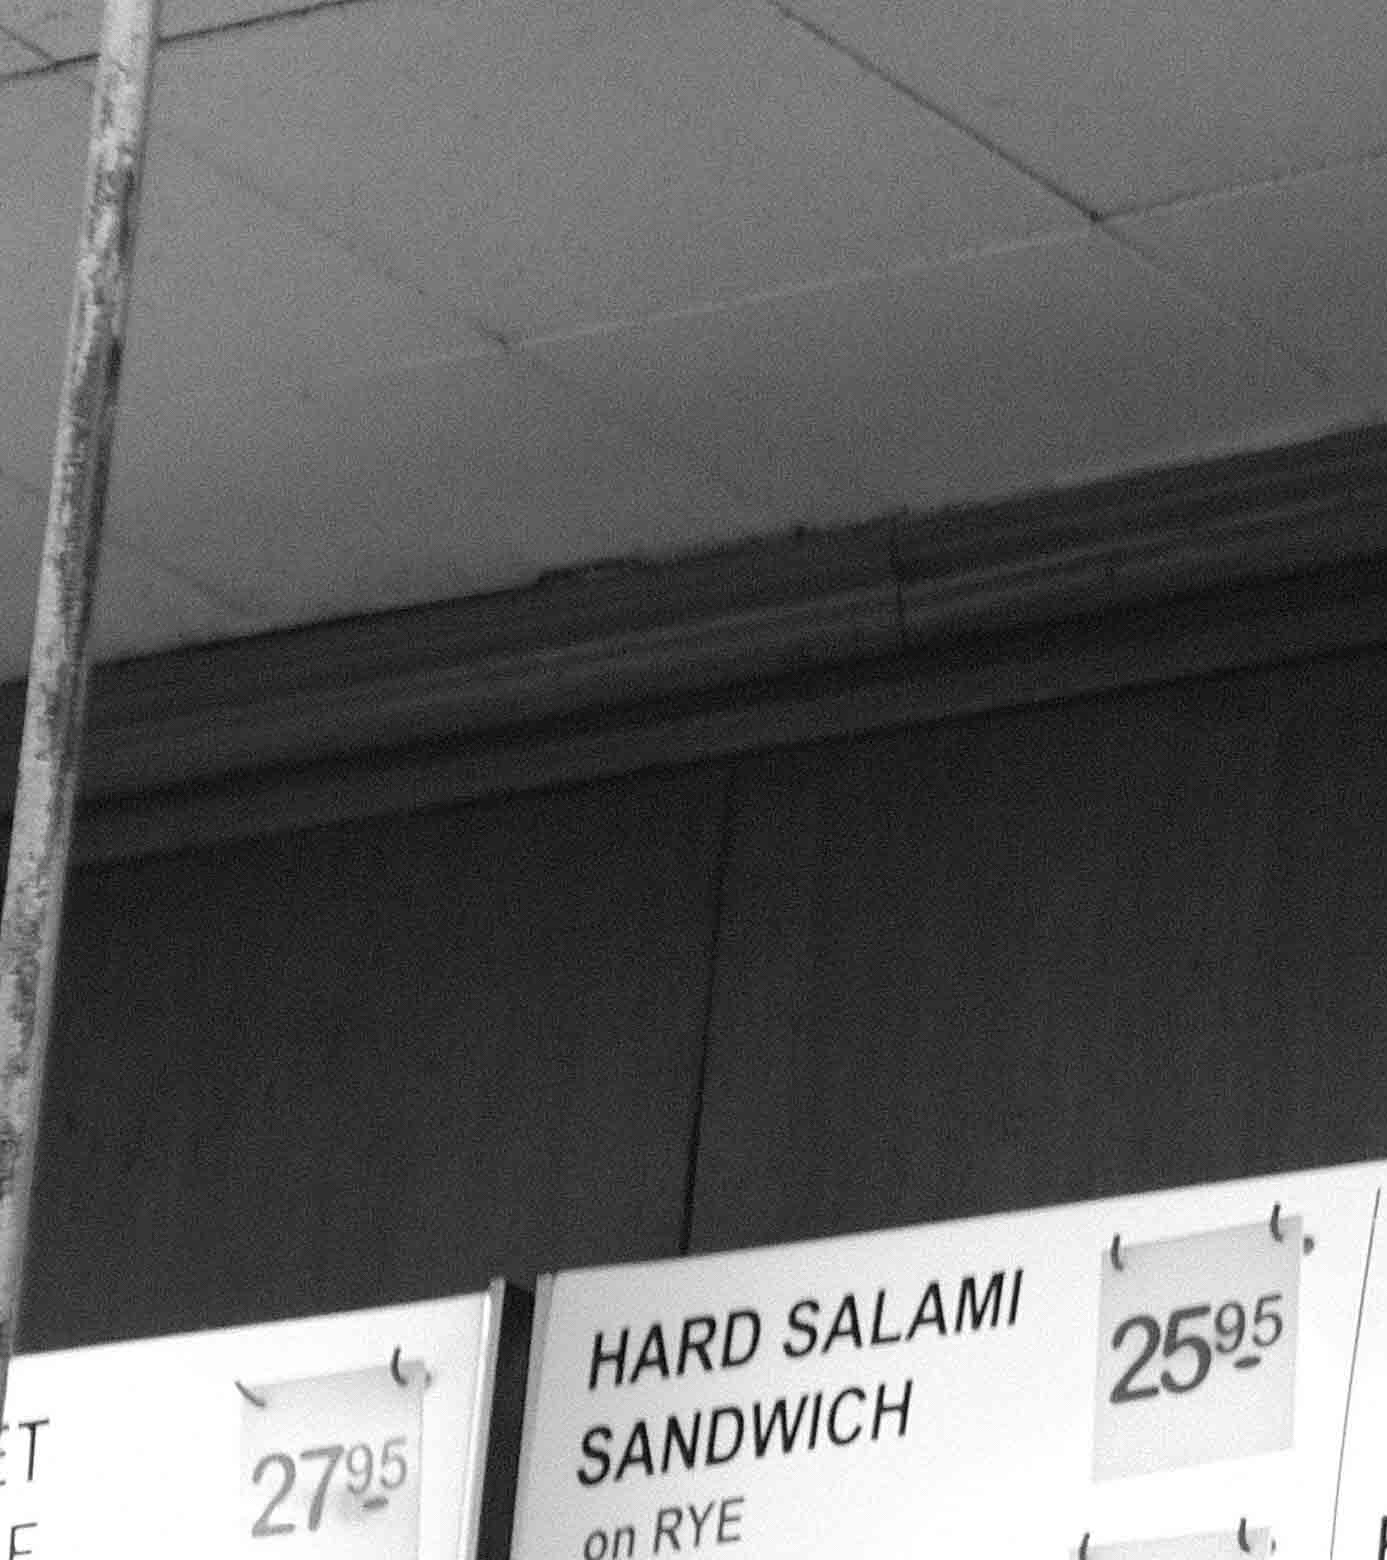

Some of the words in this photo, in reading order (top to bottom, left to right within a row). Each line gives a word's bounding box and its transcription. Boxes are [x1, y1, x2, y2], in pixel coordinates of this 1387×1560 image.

[585, 1307, 761, 1392] HARD
[781, 1268, 1025, 1359] SALAMI
[575, 1379, 914, 1487] SANDWICH
[652, 1496, 747, 1553] RYE
